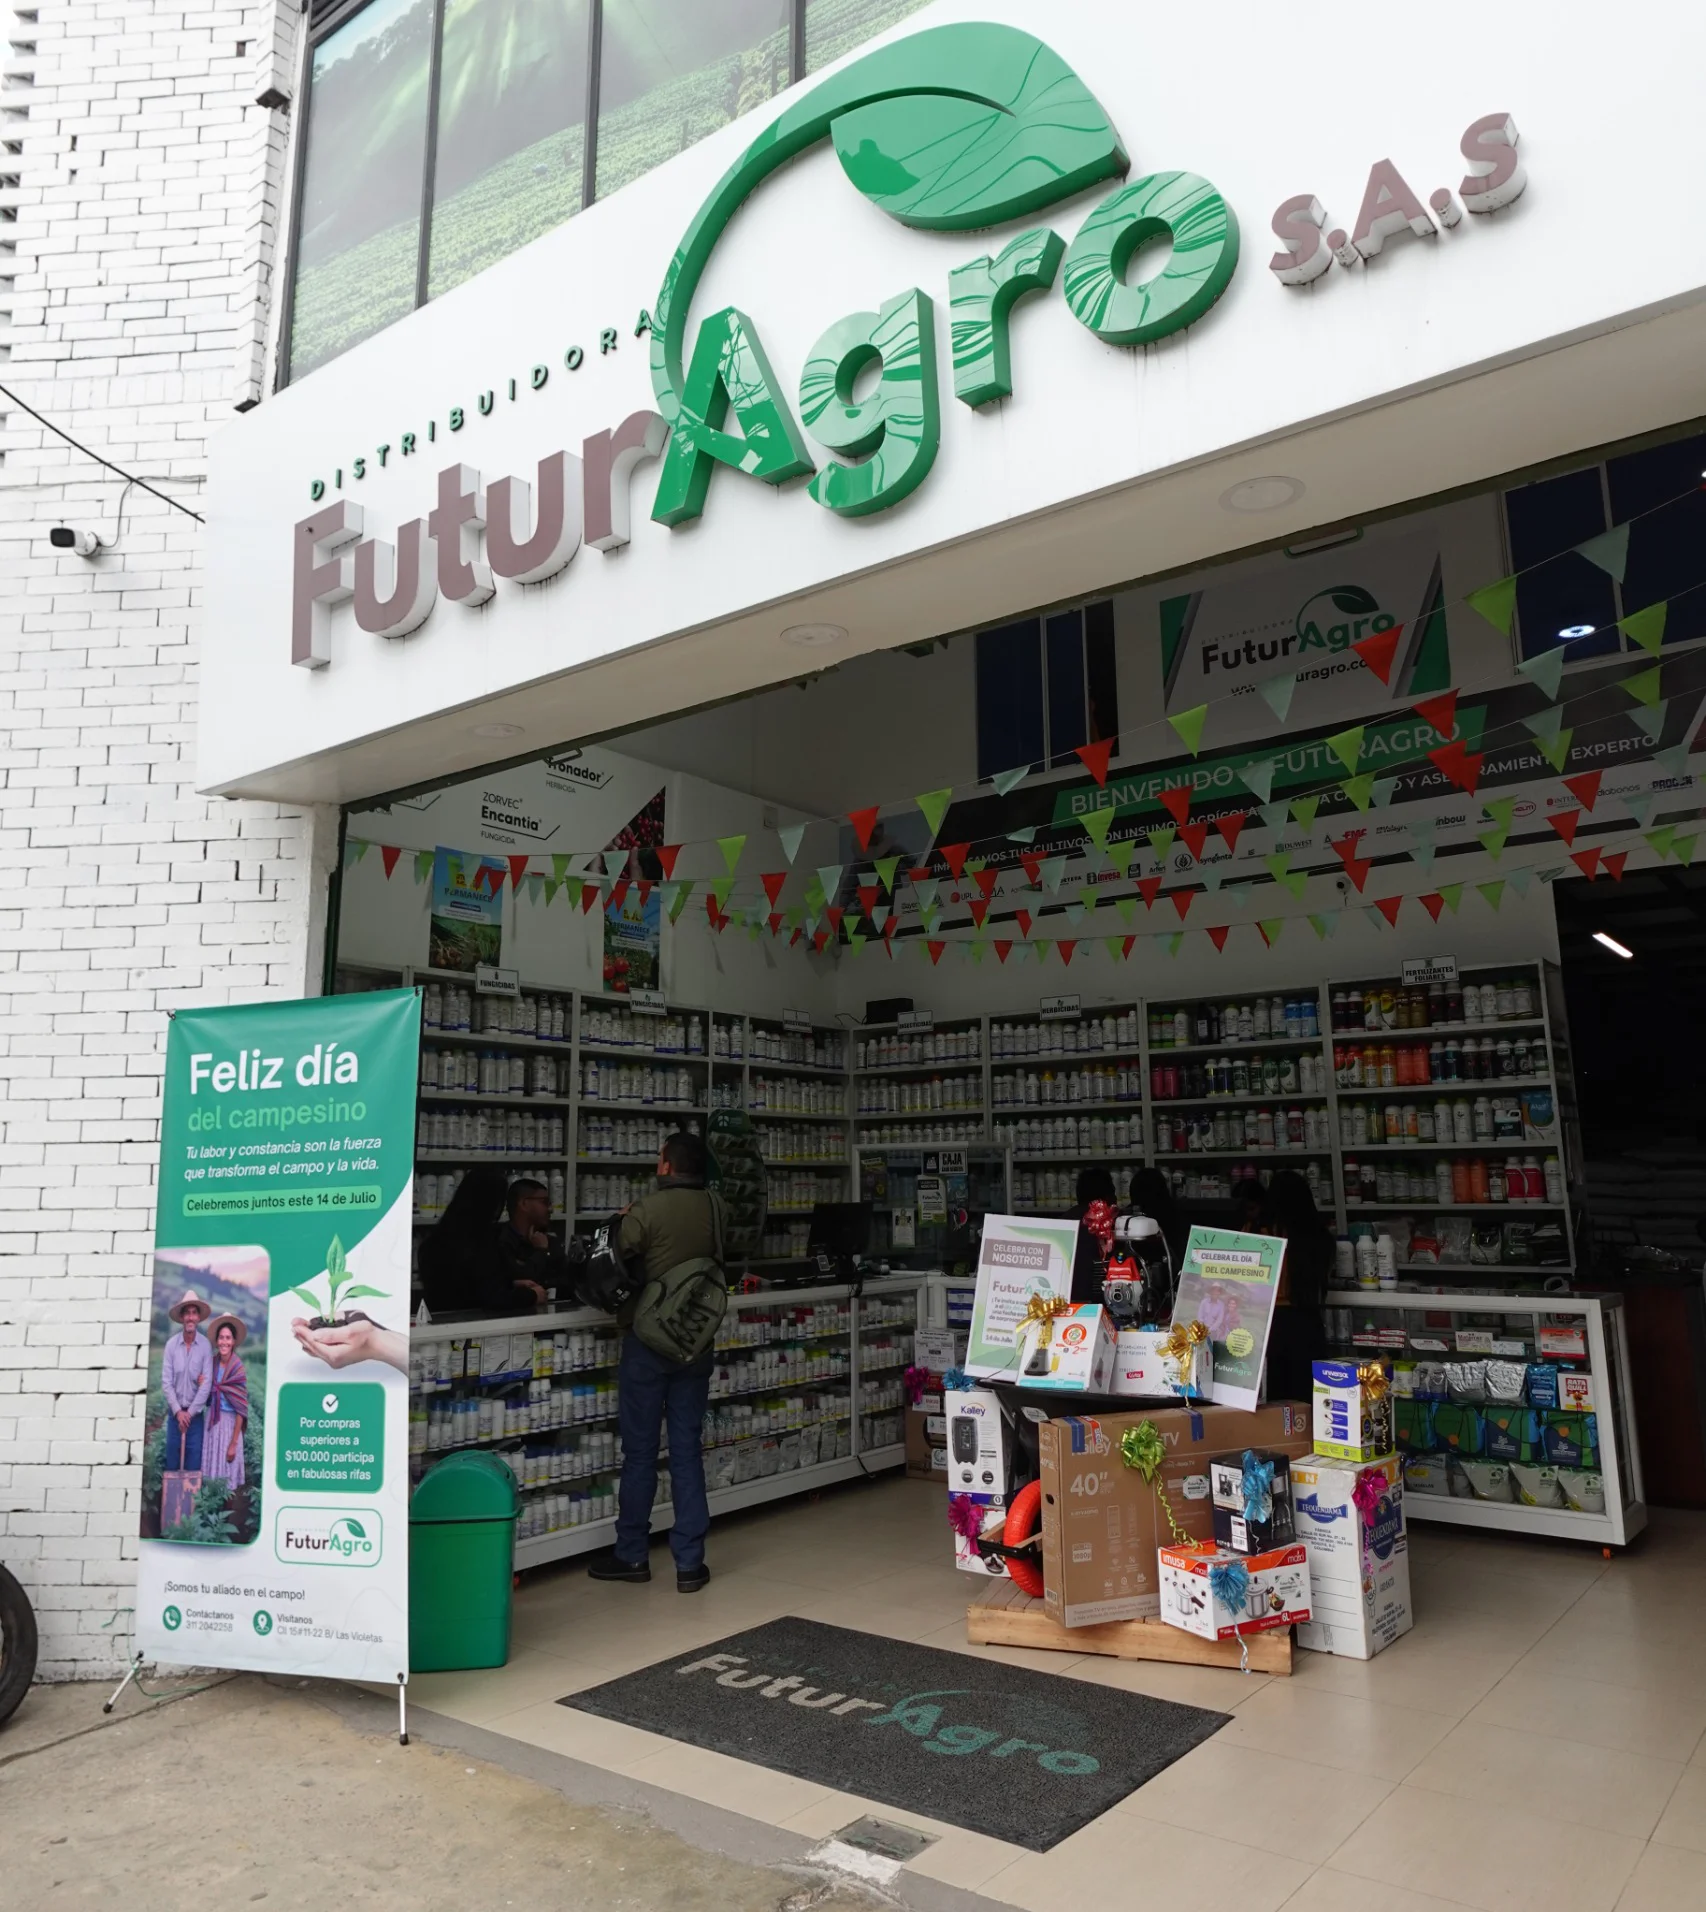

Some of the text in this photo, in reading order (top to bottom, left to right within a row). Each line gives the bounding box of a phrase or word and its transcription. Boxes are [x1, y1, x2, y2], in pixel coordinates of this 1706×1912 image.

[309, 308, 653, 502] DISTRIBUIDORA
[291, 168, 1241, 670] FuturAgro
[1202, 612, 1395, 674] FuturAgro
[1072, 765, 1235, 816] BIENVENIDO
[481, 805, 539, 832] Encantia
[481, 830, 516, 845] FUNGICIDA
[1033, 836, 1092, 856] CULTIVOS
[1199, 854, 1233, 866] syngenta
[1405, 965, 1455, 978] FERTILIZANTES
[479, 979, 516, 991] FUNGICIDAS
[1042, 1004, 1079, 1014] HERBICIDAS
[190, 1043, 359, 1095] Feliz día
[188, 1097, 367, 1132] del campesino
[186, 1136, 382, 1161] Tu labor y constancia son la fuerza
[942, 1152, 963, 1166] CAJA
[184, 1157, 379, 1182] que transforma el campo y la vida.
[187, 1191, 377, 1212] Celebremos juntos este 14 de Julio
[993, 1243, 1044, 1256] CELEBRA CON
[991, 1254, 1043, 1266] NOSOTROS
[1201, 1252, 1253, 1263] CELEBRA EL DÍA
[1205, 1265, 1264, 1278] DEL CAMPESINO
[1214, 1362, 1252, 1376] FuturAgro
[960, 1404, 986, 1418] Kalley
[300, 1416, 361, 1432] Por compras
[300, 1434, 360, 1448] superiores a
[1163, 1432, 1180, 1447] TV
[285, 1450, 375, 1465] $100.000 participa
[287, 1466, 372, 1481] en fabulosas rifas
[285, 1531, 373, 1557] FuturAgro
[1163, 1553, 1186, 1569] imusa
[164, 1580, 306, 1602] ¡Somos tu aliado en el campo!
[1281, 1611, 1291, 1622] 6L
[336, 1630, 350, 1641] Las
[350, 1631, 384, 1644] Violetas
[676, 1652, 1101, 1776] FuturAgro
